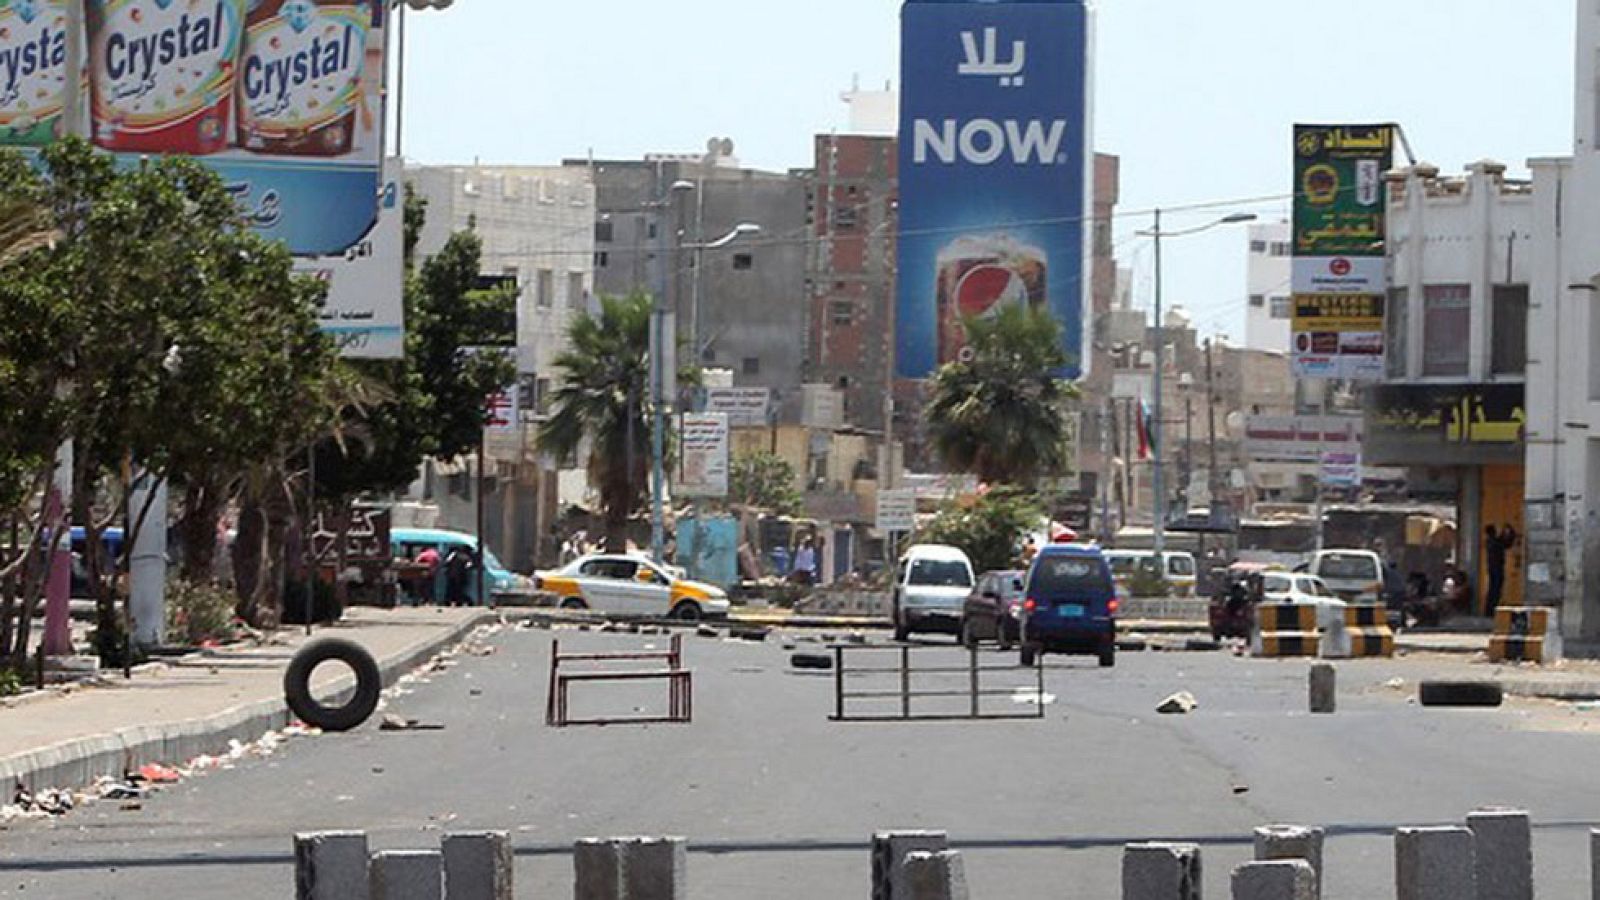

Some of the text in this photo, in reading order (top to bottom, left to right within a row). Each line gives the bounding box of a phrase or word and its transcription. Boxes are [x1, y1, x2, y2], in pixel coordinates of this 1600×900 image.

[105, 0, 224, 81] Crystal
[244, 24, 352, 100] Crystal
[958, 28, 1025, 87] يلا
